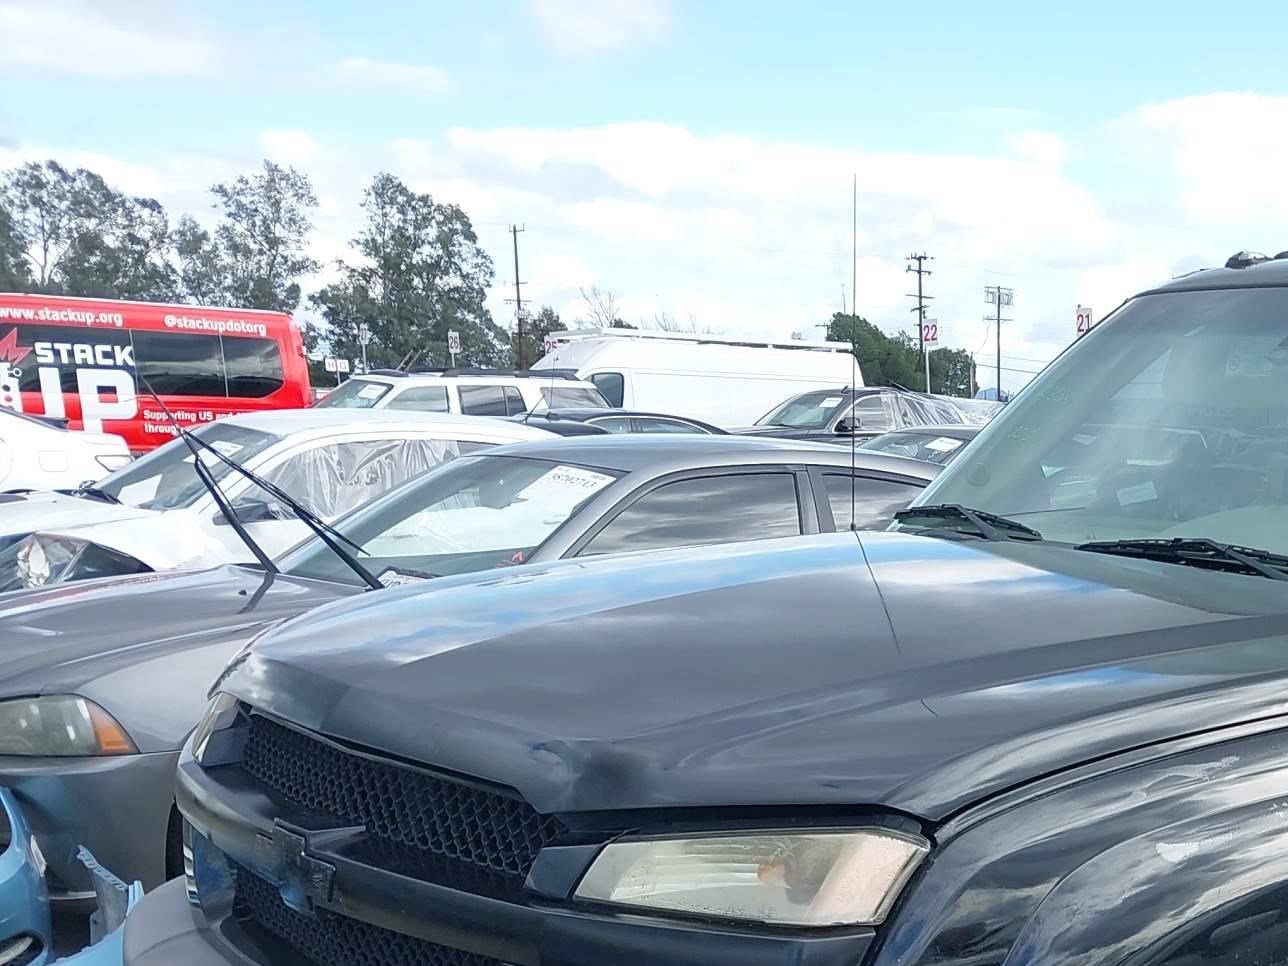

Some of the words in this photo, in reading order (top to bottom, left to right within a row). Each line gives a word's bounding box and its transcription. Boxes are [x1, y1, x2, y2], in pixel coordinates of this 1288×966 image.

[164, 315, 267, 336] @stackupdotorg
[1076, 314, 1091, 332] 21
[923, 324, 938, 342] 22
[449, 335, 459, 350] 26
[34, 342, 136, 367] STACK
[198, 411, 213, 421] US
